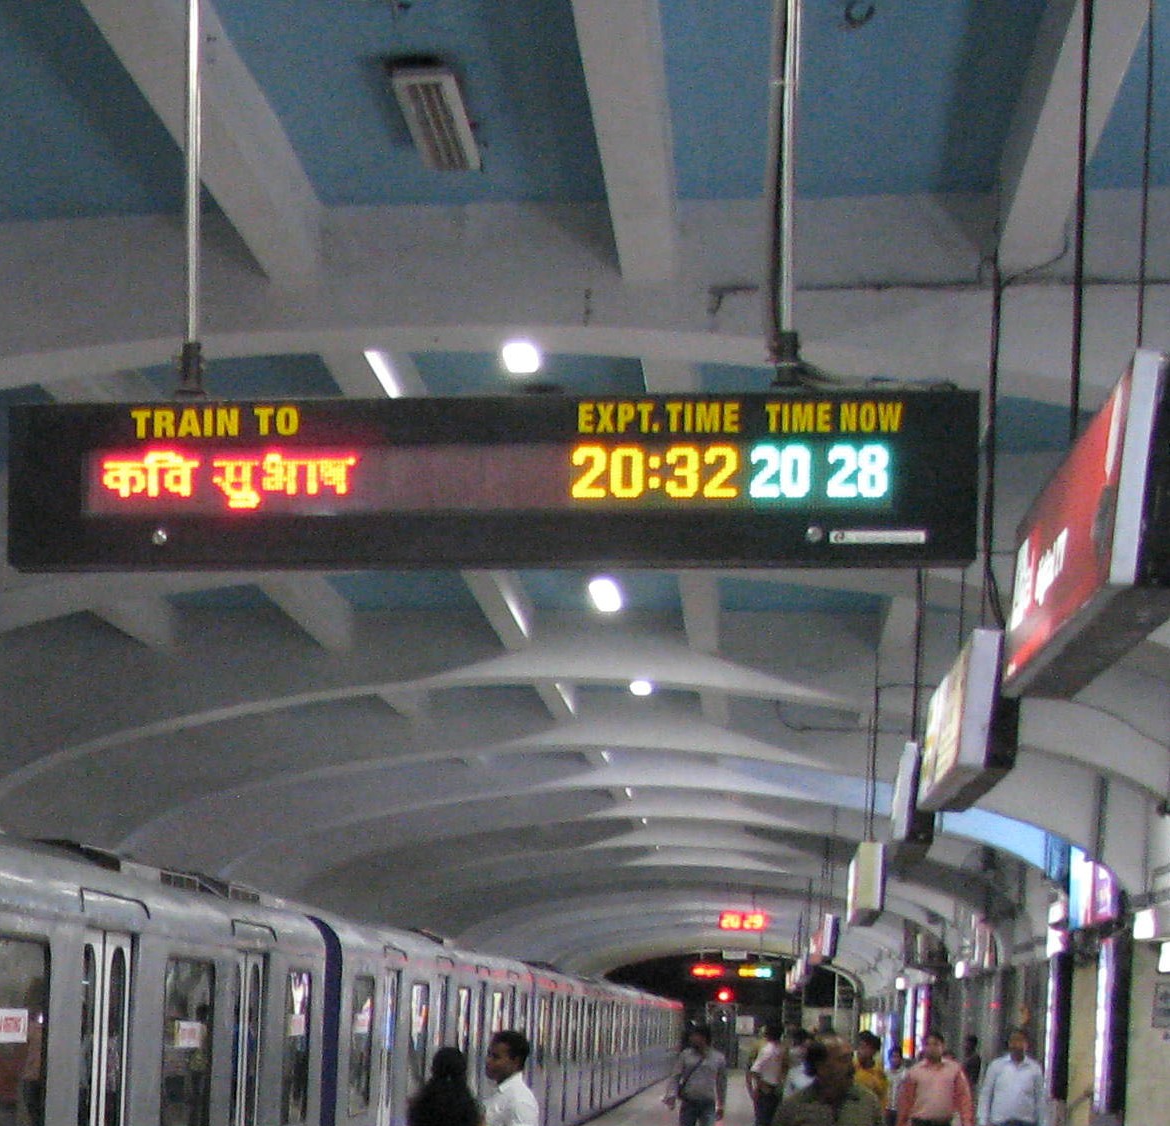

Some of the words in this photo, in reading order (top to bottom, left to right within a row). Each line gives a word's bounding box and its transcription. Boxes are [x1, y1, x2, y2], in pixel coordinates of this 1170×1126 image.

[130, 408, 240, 438] TRAIN
[254, 406, 300, 436] TO
[765, 402, 832, 433] TIME
[840, 402, 904, 433] NOW
[102, 450, 200, 498] कवि
[212, 452, 357, 508] सुभाष
[571, 445, 739, 498] 20:32
[749, 444, 812, 498] 20
[826, 444, 890, 498] 28
